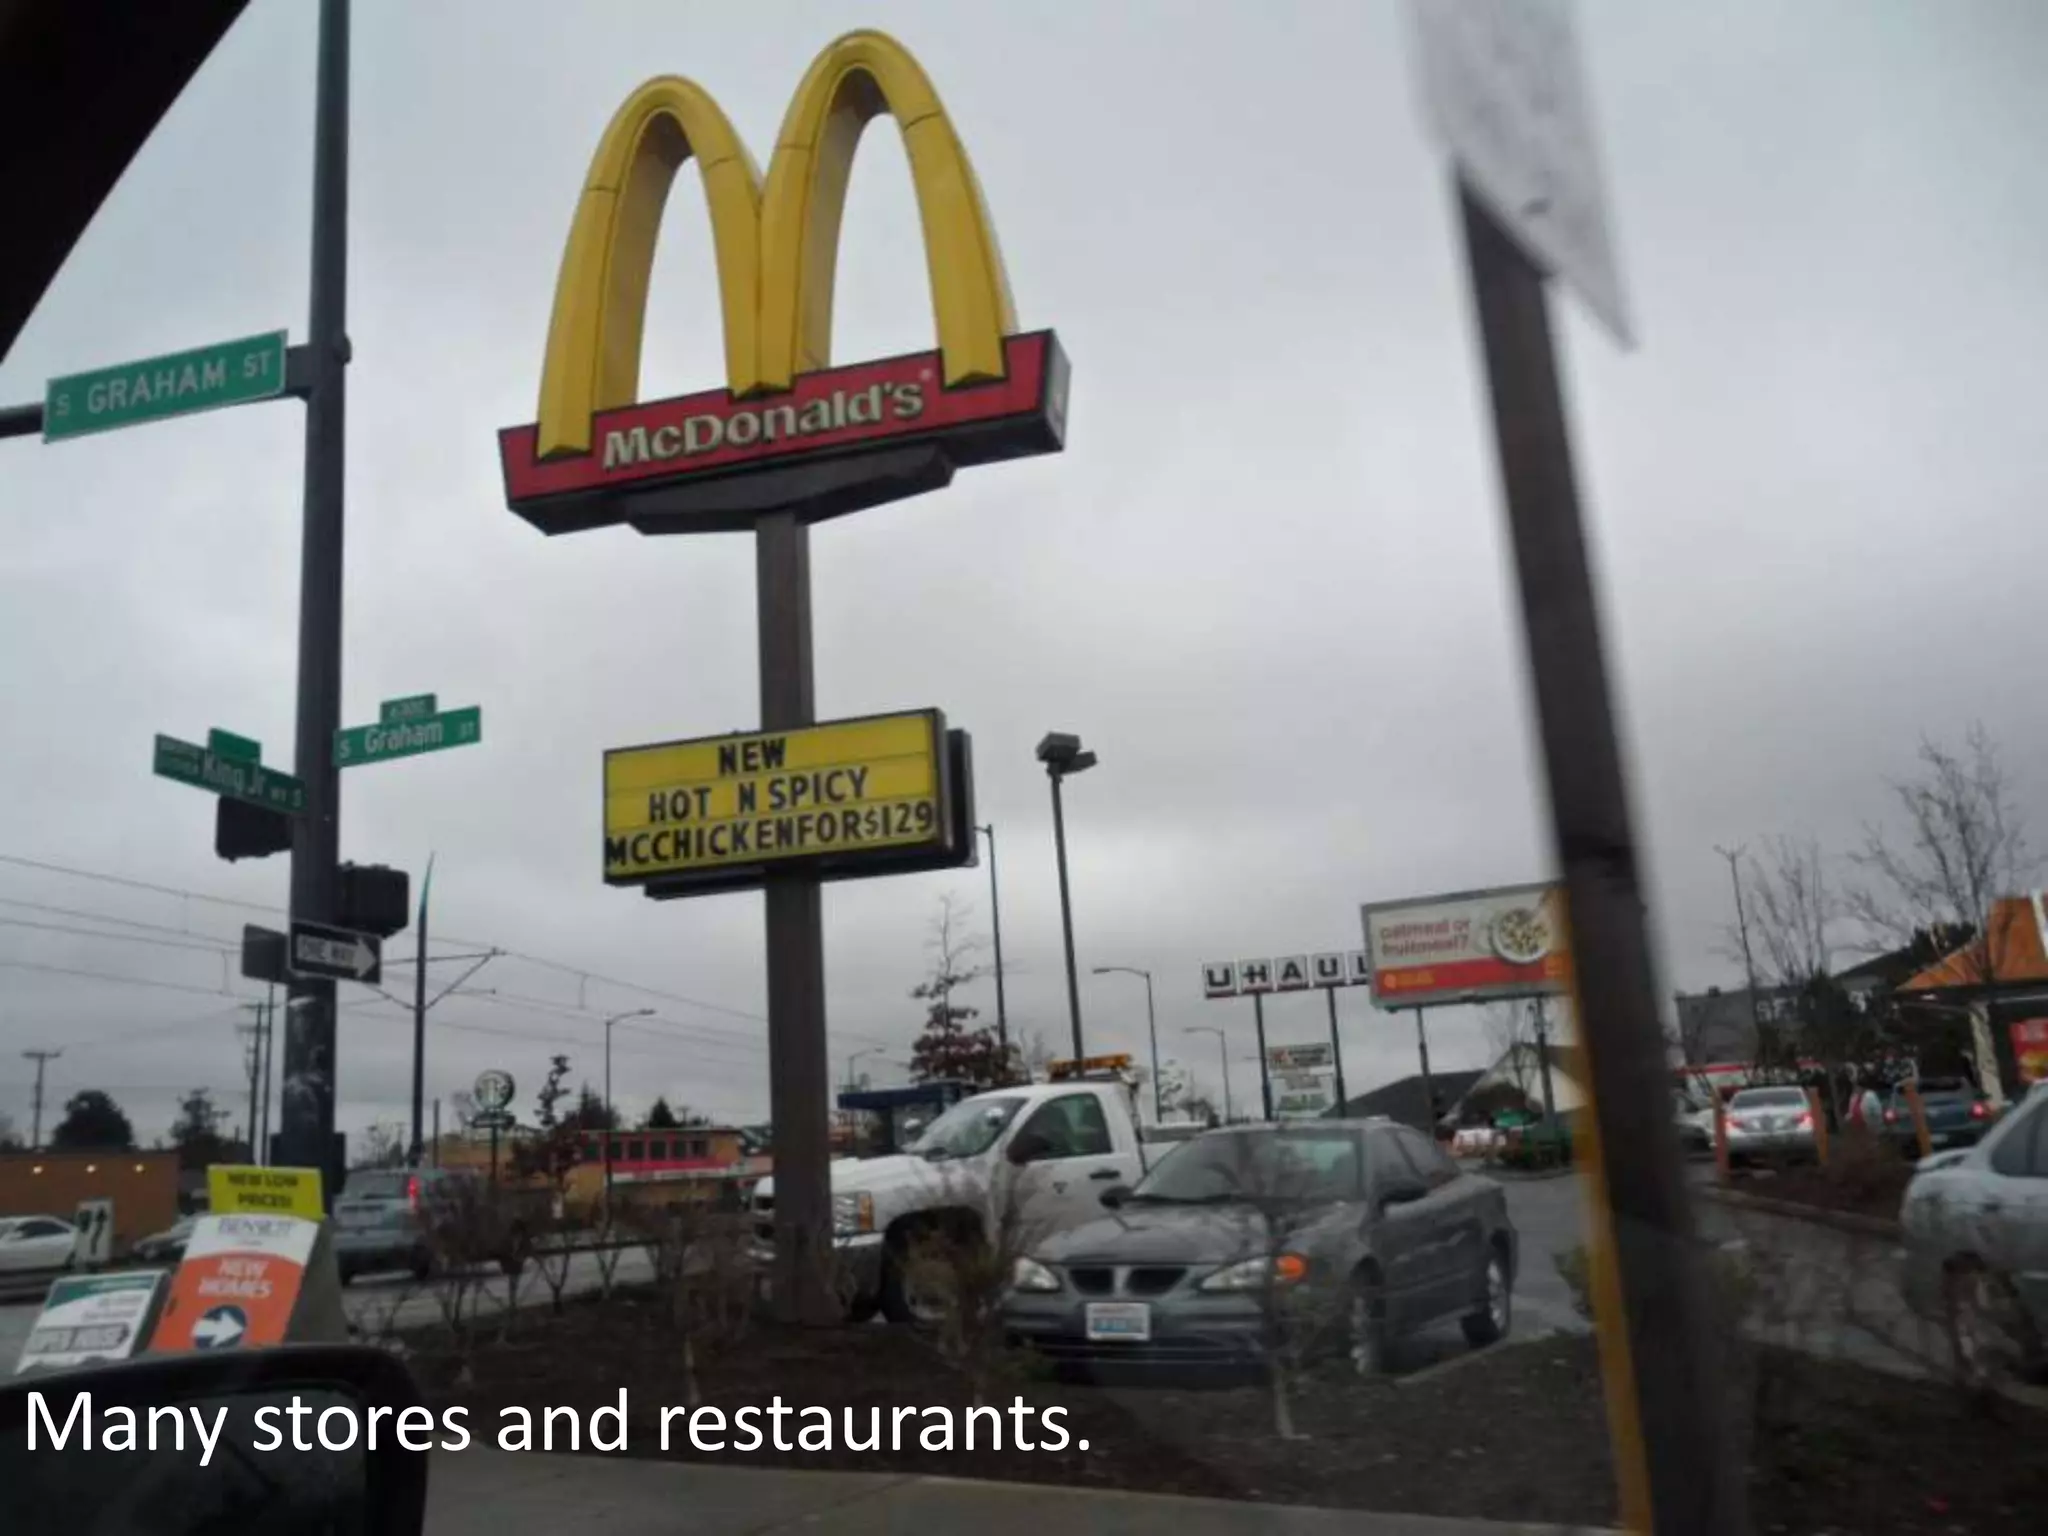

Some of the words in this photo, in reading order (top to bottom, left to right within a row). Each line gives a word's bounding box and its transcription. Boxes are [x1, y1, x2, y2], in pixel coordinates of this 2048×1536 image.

[55, 394, 70, 417] S
[87, 357, 227, 415] GRAHAM
[242, 350, 272, 378] ST
[602, 380, 925, 471] McDonald's
[364, 720, 443, 755] Graham
[718, 737, 787, 775] NEW
[202, 751, 245, 796] King
[649, 787, 711, 824] HOT
[738, 782, 757, 815] N
[767, 766, 869, 812] SPICY
[218, 1258, 270, 1278] NEW
